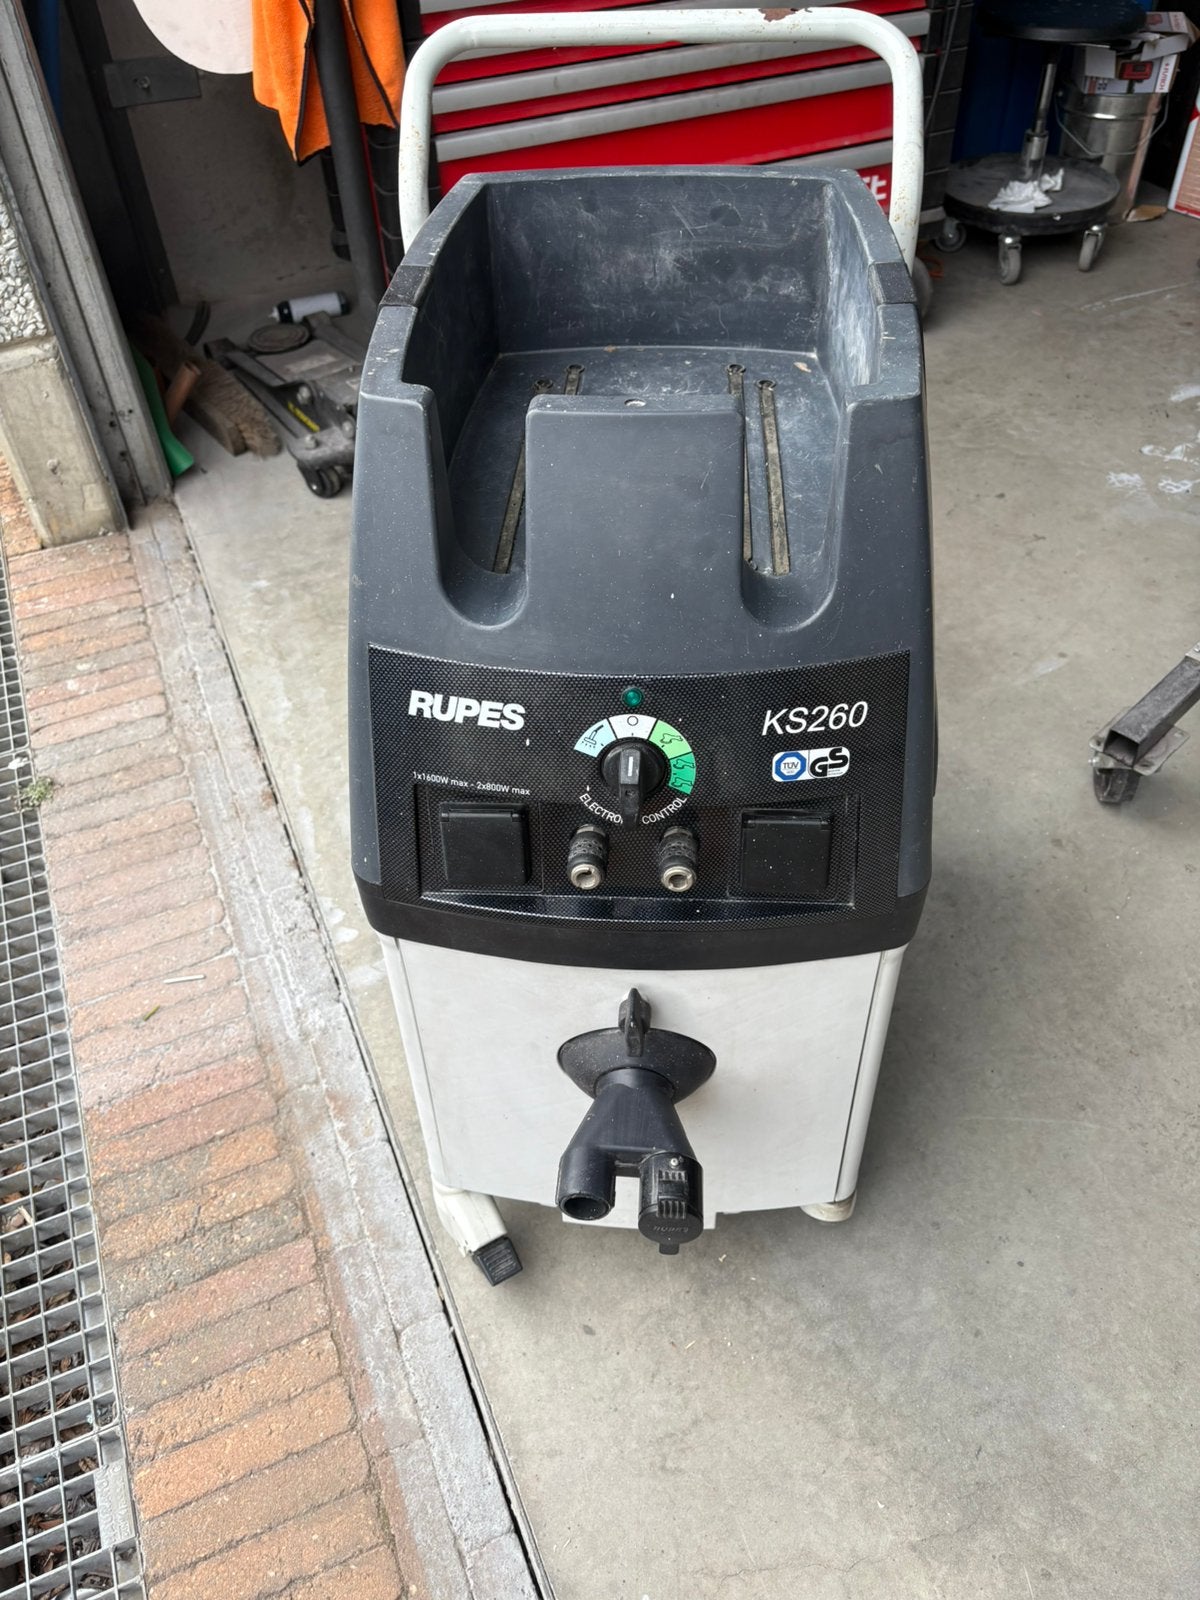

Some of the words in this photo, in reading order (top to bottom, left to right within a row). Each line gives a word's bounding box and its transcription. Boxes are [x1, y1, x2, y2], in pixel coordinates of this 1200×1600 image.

[408, 689, 526, 731] RUPES
[761, 701, 869, 736] KS260
[810, 747, 849, 777] GS
[413, 771, 449, 785] 1x1600W
[450, 779, 469, 787] max
[476, 781, 510, 793] 2x800W
[511, 787, 531, 796] max
[579, 793, 624, 825] ELECTRO
[641, 796, 688, 825] CONTROL
